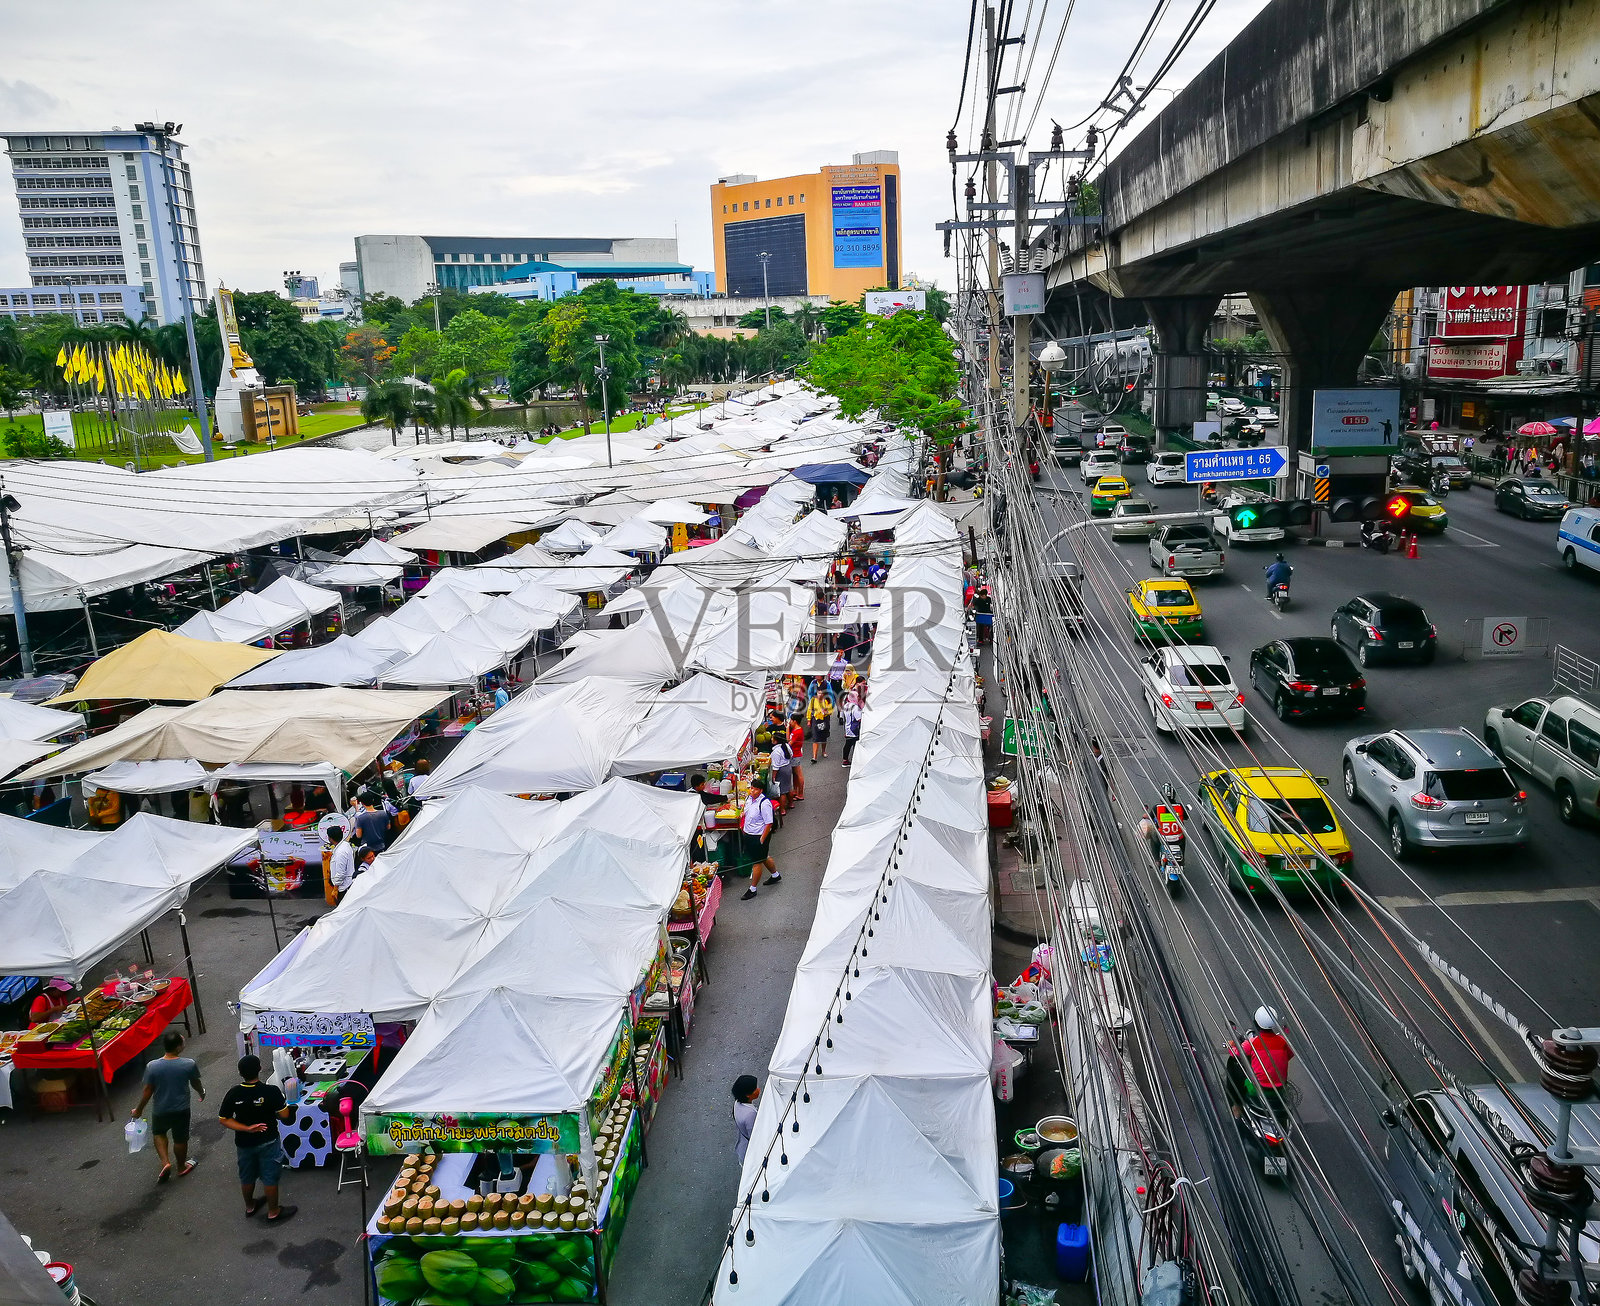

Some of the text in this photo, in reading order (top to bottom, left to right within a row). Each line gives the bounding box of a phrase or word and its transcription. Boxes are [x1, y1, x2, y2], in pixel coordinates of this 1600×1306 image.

[1343, 415, 1367, 424] 1155
[1193, 453, 1244, 469] รามคำแหง
[1259, 454, 1271, 464] 65
[1193, 469, 1244, 479] Ramkhamhaeng
[1162, 822, 1179, 834] 50
